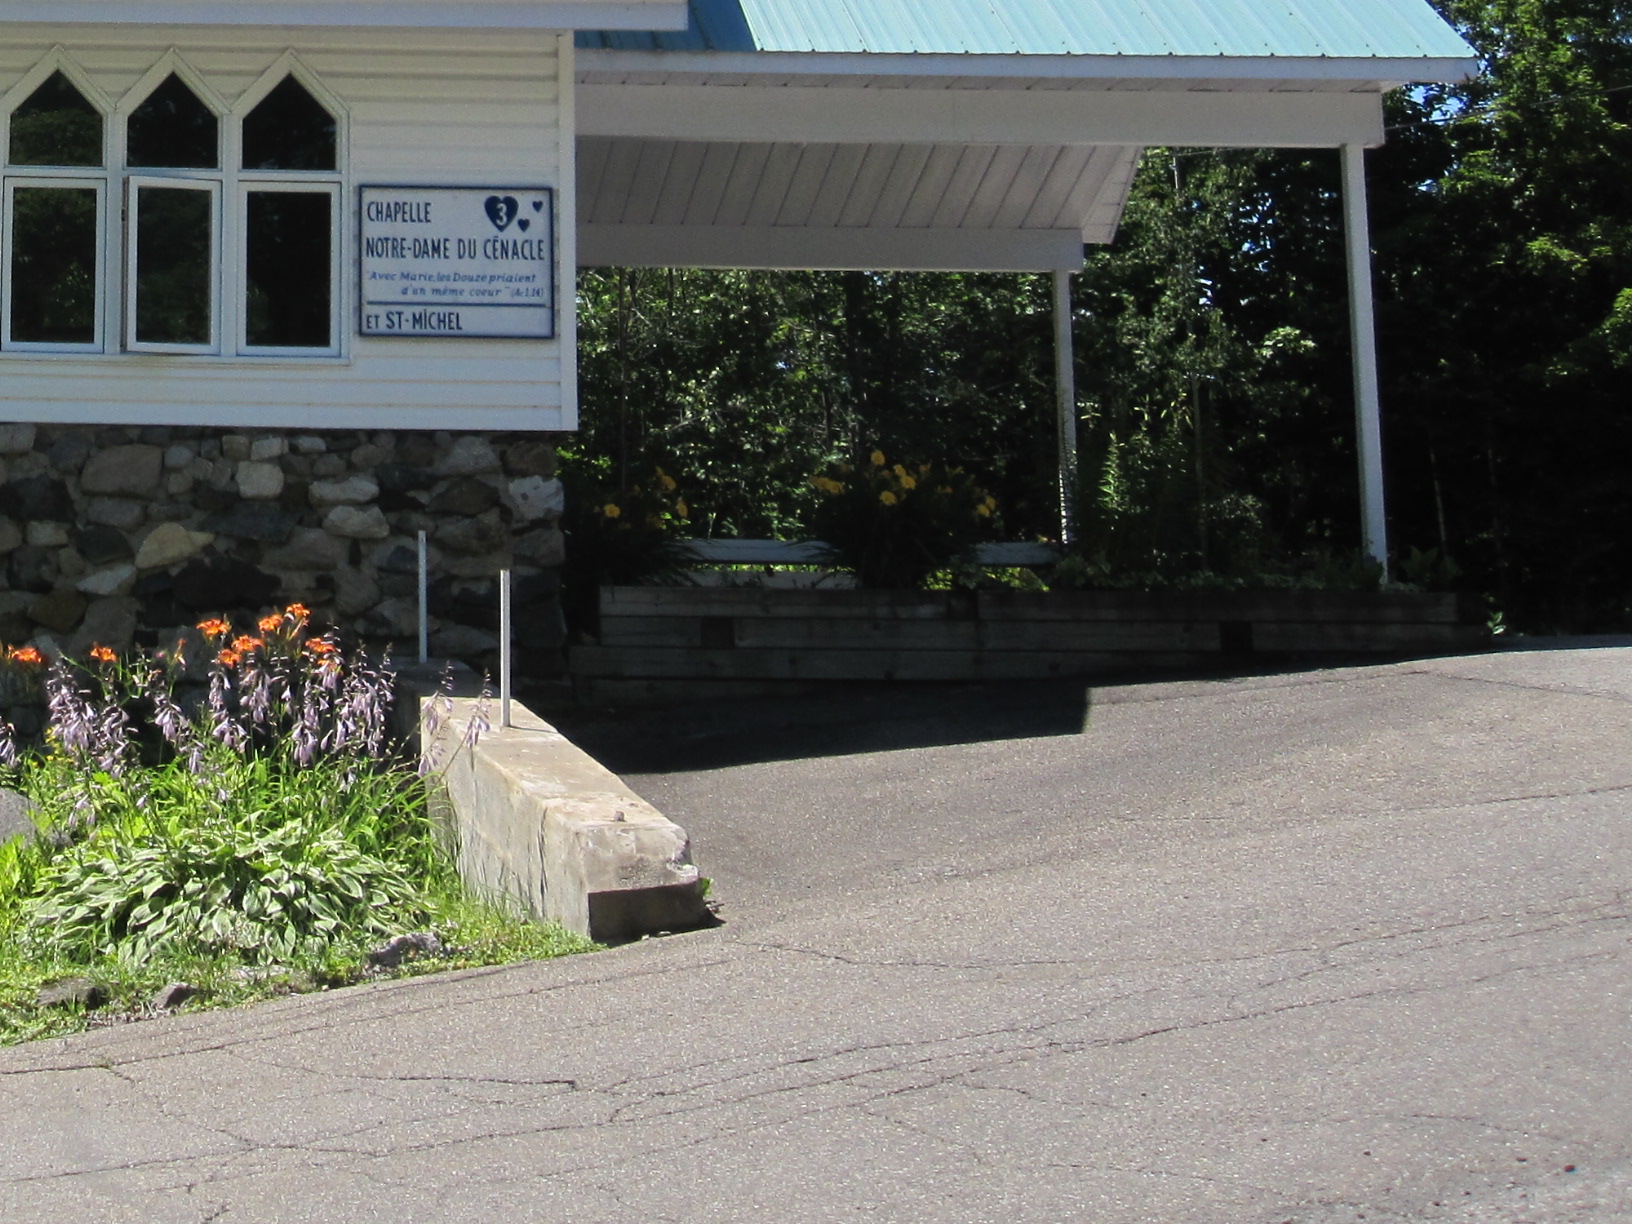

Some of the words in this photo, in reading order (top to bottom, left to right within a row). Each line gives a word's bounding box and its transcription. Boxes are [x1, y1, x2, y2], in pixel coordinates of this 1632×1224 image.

[367, 201, 431, 223] CHAPELLE
[495, 203, 508, 226] 3
[366, 237, 450, 259] NOTRE-DAME
[458, 238, 477, 259] DU
[483, 236, 545, 260] CÉNACLE
[452, 272, 487, 282] Douze
[488, 273, 536, 286] priaient
[366, 315, 380, 330] ET
[386, 309, 463, 331] ST-MICHEL
